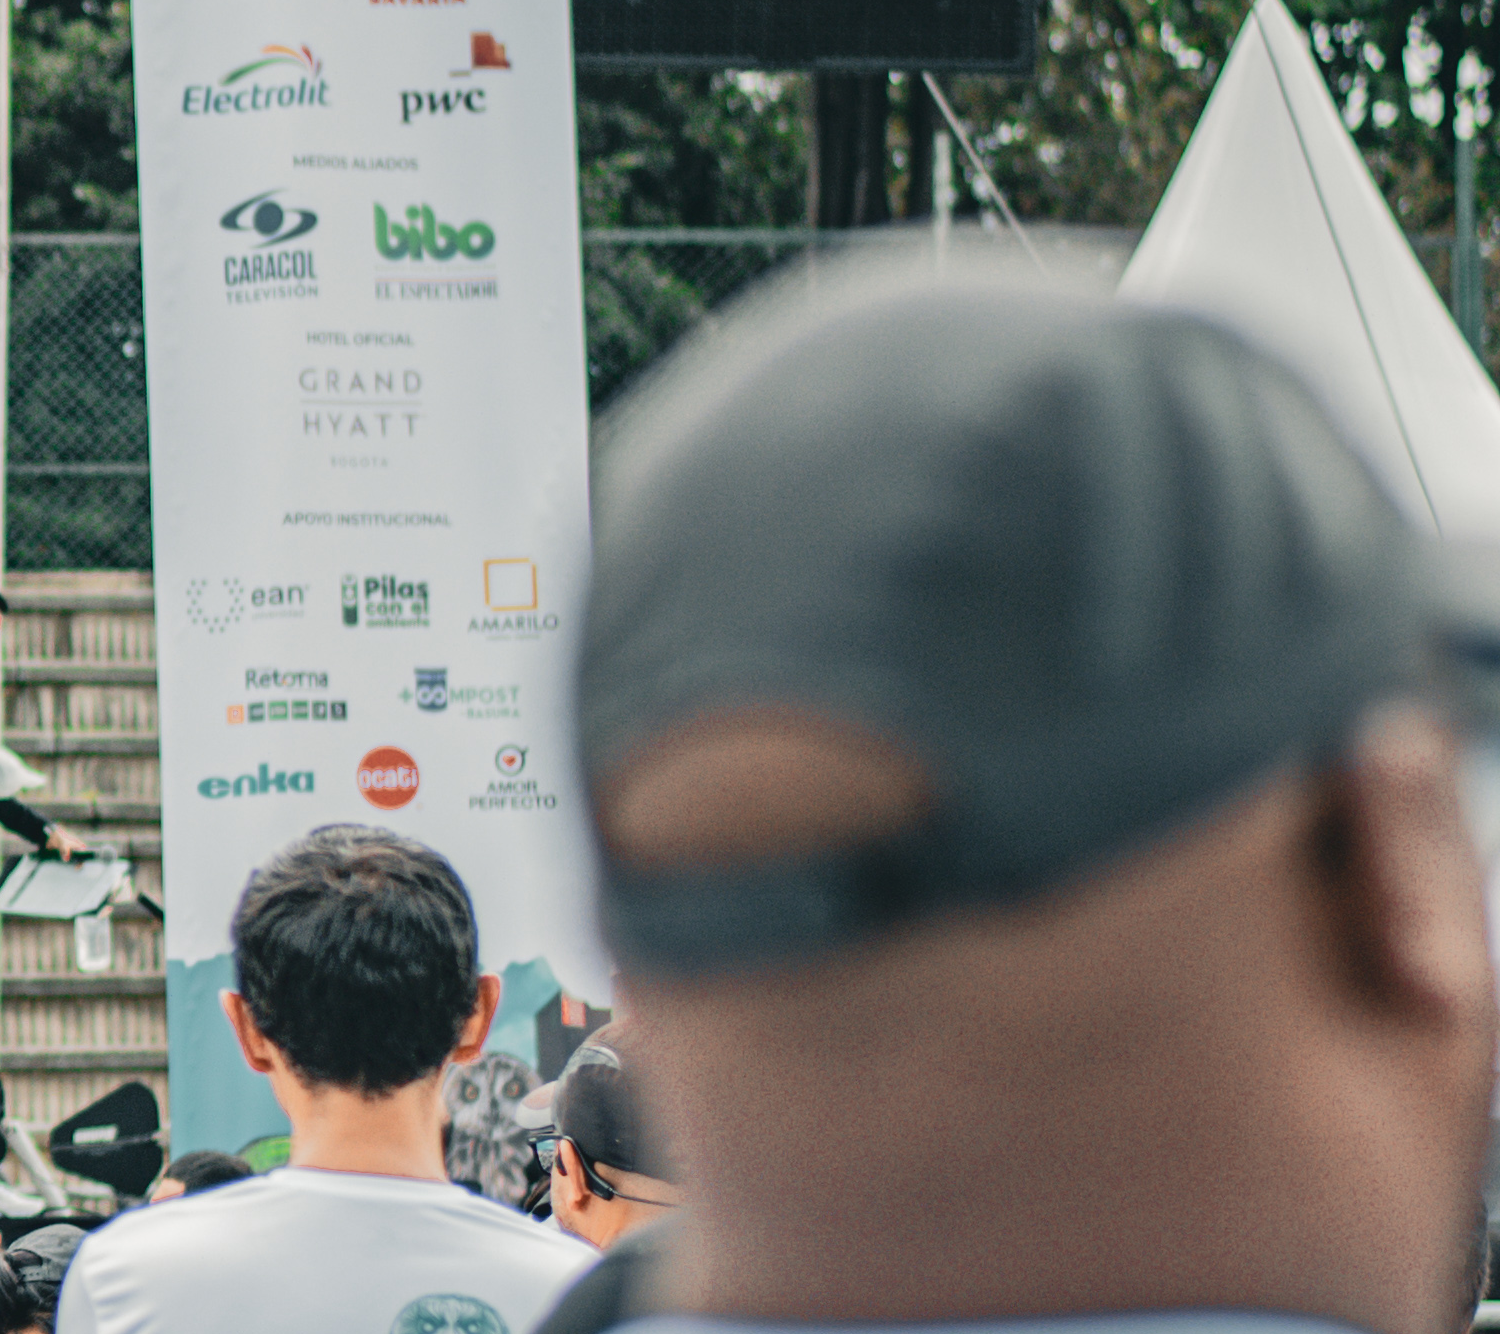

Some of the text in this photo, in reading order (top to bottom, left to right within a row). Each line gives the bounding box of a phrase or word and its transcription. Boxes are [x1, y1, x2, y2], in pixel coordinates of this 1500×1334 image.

[182, 79, 330, 115] Electrolit
[400, 86, 486, 124] pwc
[293, 155, 347, 169] MEDIOS
[373, 201, 496, 262] bibo
[224, 250, 317, 286] CARACOL
[306, 332, 349, 345] HOTEL
[299, 369, 422, 395] GRAND
[303, 413, 422, 438] HYATT
[282, 512, 452, 528] APOYO INSTITUCIONAL
[251, 585, 304, 608] ean
[364, 575, 429, 601] Pilas
[467, 615, 560, 634] AMARILO
[245, 669, 329, 691] Retorna
[198, 762, 315, 799] enka
[487, 781, 538, 795] AMOR
[469, 794, 557, 811] PERFECTO
